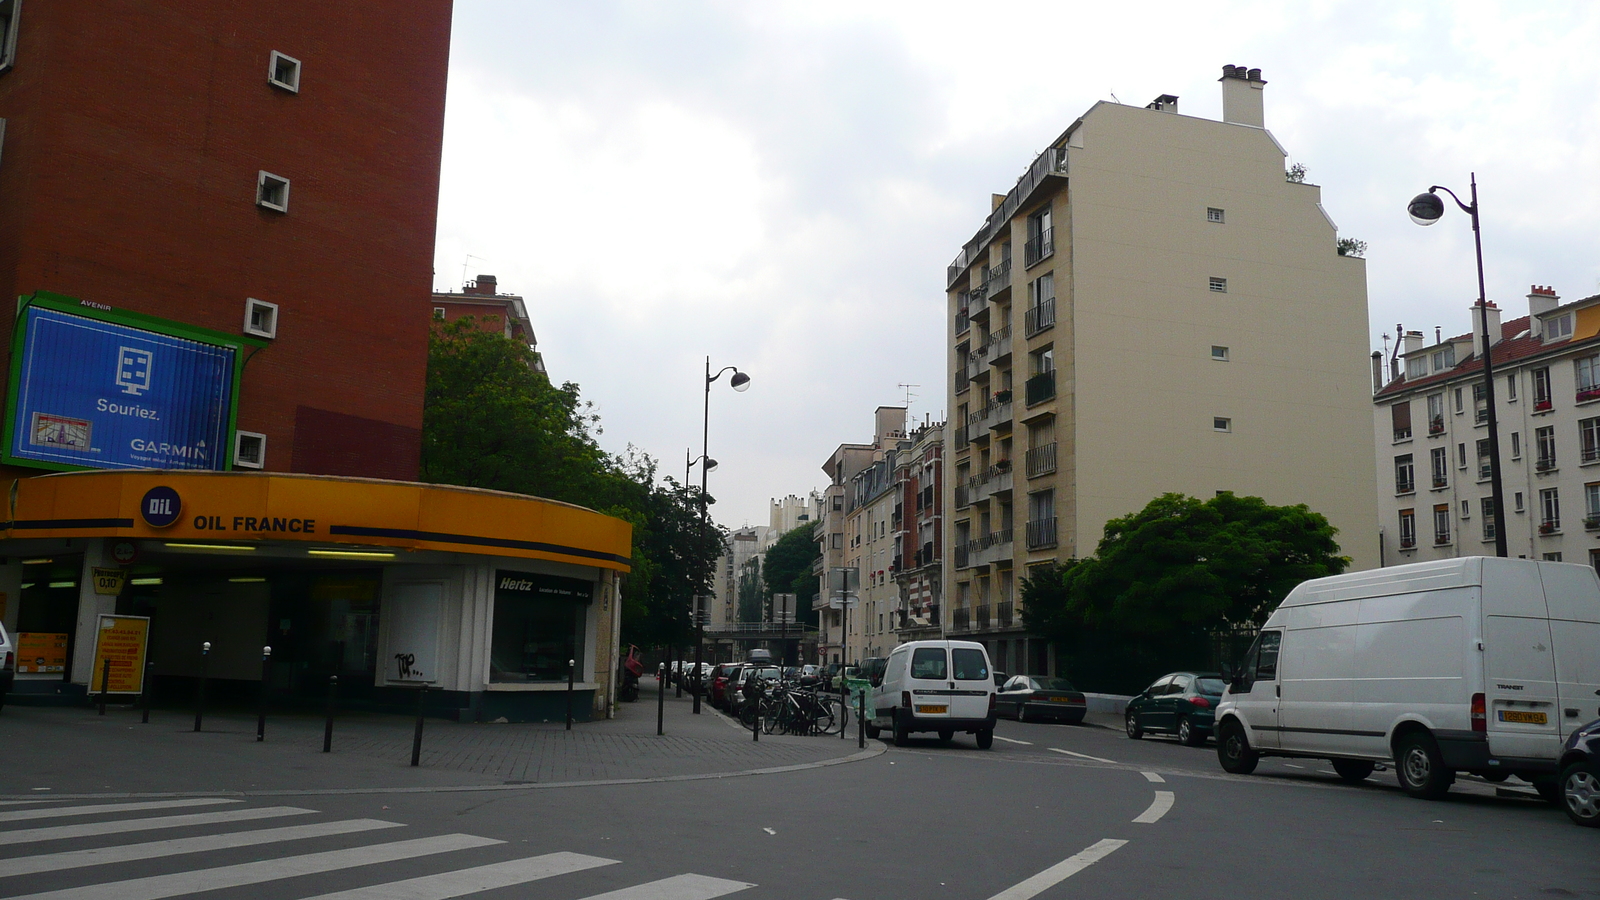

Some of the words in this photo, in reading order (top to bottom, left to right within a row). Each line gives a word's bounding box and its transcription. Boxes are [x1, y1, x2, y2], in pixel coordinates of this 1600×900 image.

[80, 299, 112, 312] AVENIR
[96, 398, 160, 421] Souriez.
[130, 438, 208, 460] GARMIN
[193, 515, 226, 531] OIL
[233, 516, 316, 534] FRANCE
[99, 577, 117, 589] 0,10
[499, 577, 533, 591] Hertz
